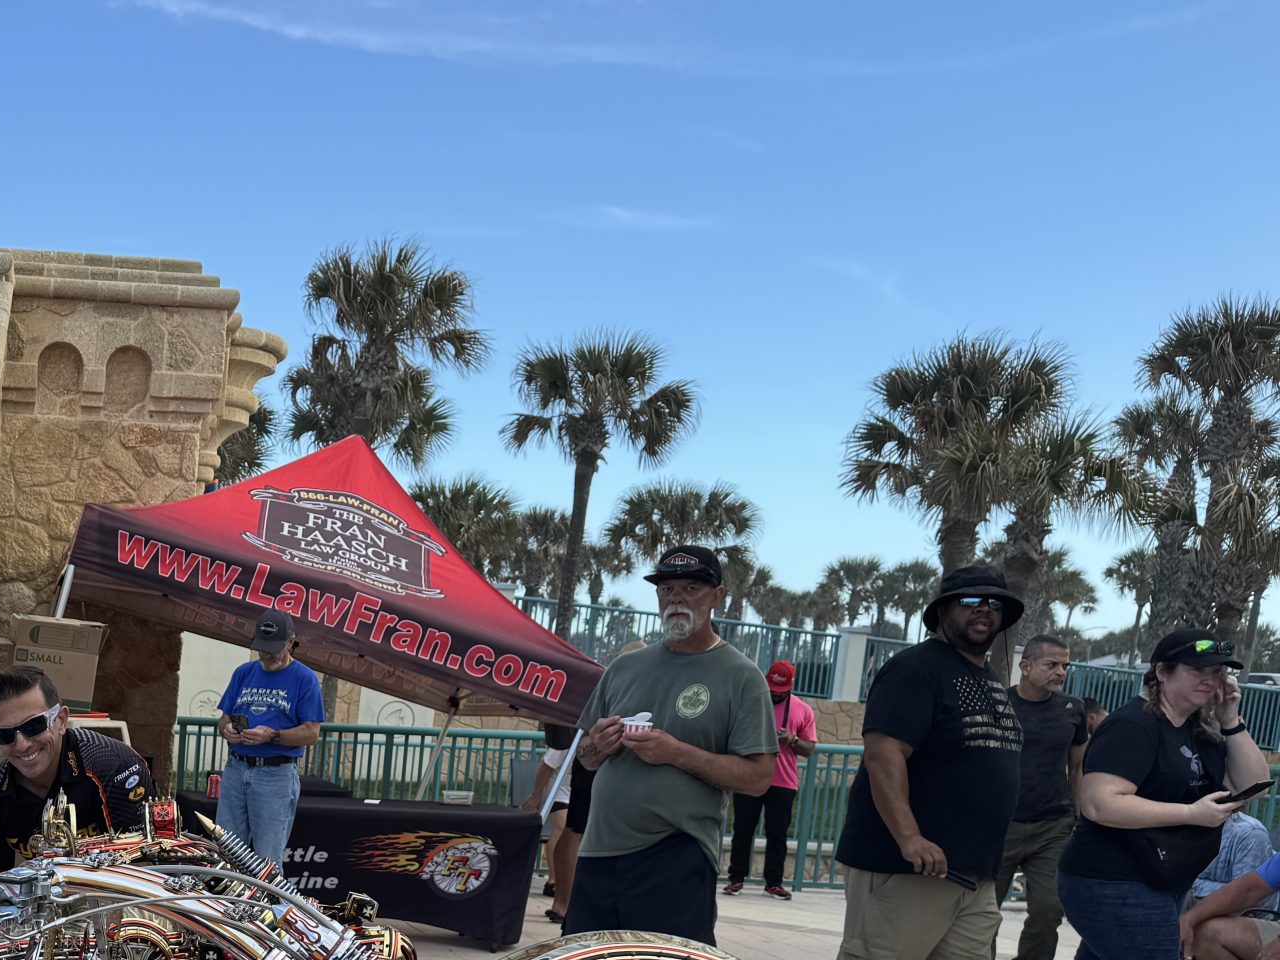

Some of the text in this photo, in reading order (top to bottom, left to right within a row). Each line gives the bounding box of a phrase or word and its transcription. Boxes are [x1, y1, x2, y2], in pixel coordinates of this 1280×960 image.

[299, 491, 400, 526] 866-LAW-FRAN
[332, 508, 364, 526] THE
[279, 521, 409, 572] HAASCH
[305, 511, 387, 549] FRAN
[299, 540, 391, 573] LAW GROUP
[293, 557, 398, 592] LawFran.com
[117, 529, 568, 703] www.LawFran.com
[29, 651, 64, 665] SMALL
[282, 845, 329, 863] ttle
[290, 871, 339, 889] zine
